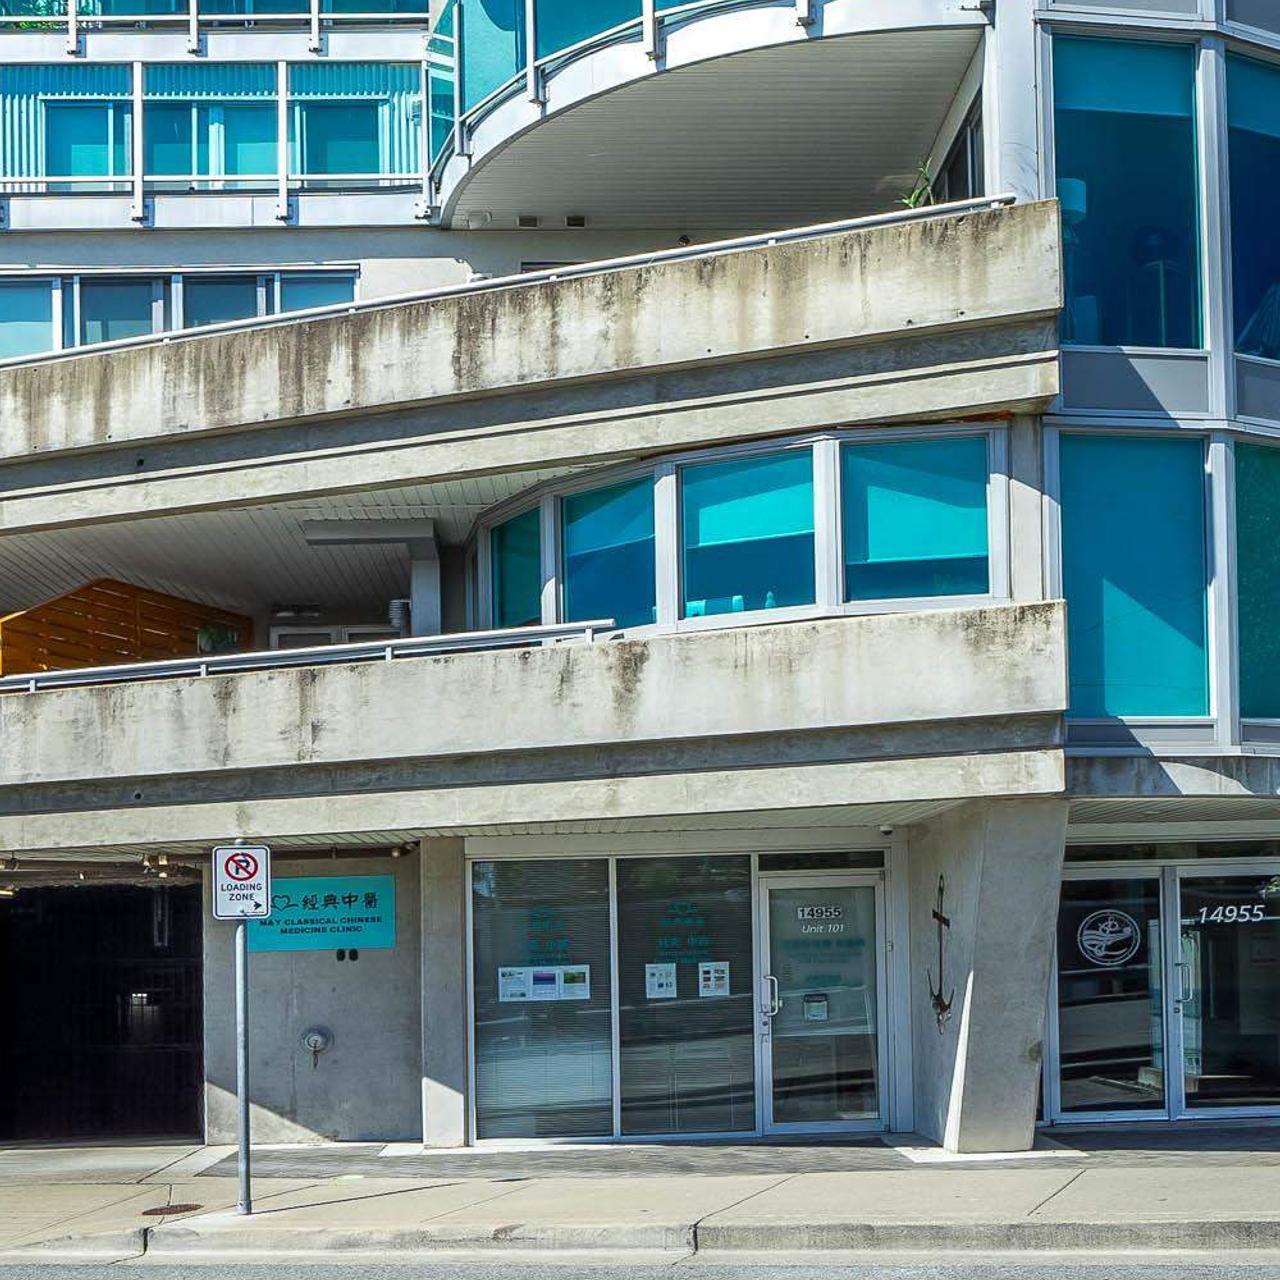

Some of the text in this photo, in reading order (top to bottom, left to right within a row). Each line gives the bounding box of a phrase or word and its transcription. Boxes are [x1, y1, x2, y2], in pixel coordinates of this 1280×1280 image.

[221, 883, 262, 891] LOADING
[228, 892, 255, 901] ZONE
[798, 907, 842, 919] 14955
[1199, 904, 1266, 924] 14955
[284, 917, 338, 926] CLASSICAL
[340, 915, 383, 924] CHINESE
[280, 925, 364, 934] MEDICINE CLINIC
[802, 923, 844, 934] Unit 101
